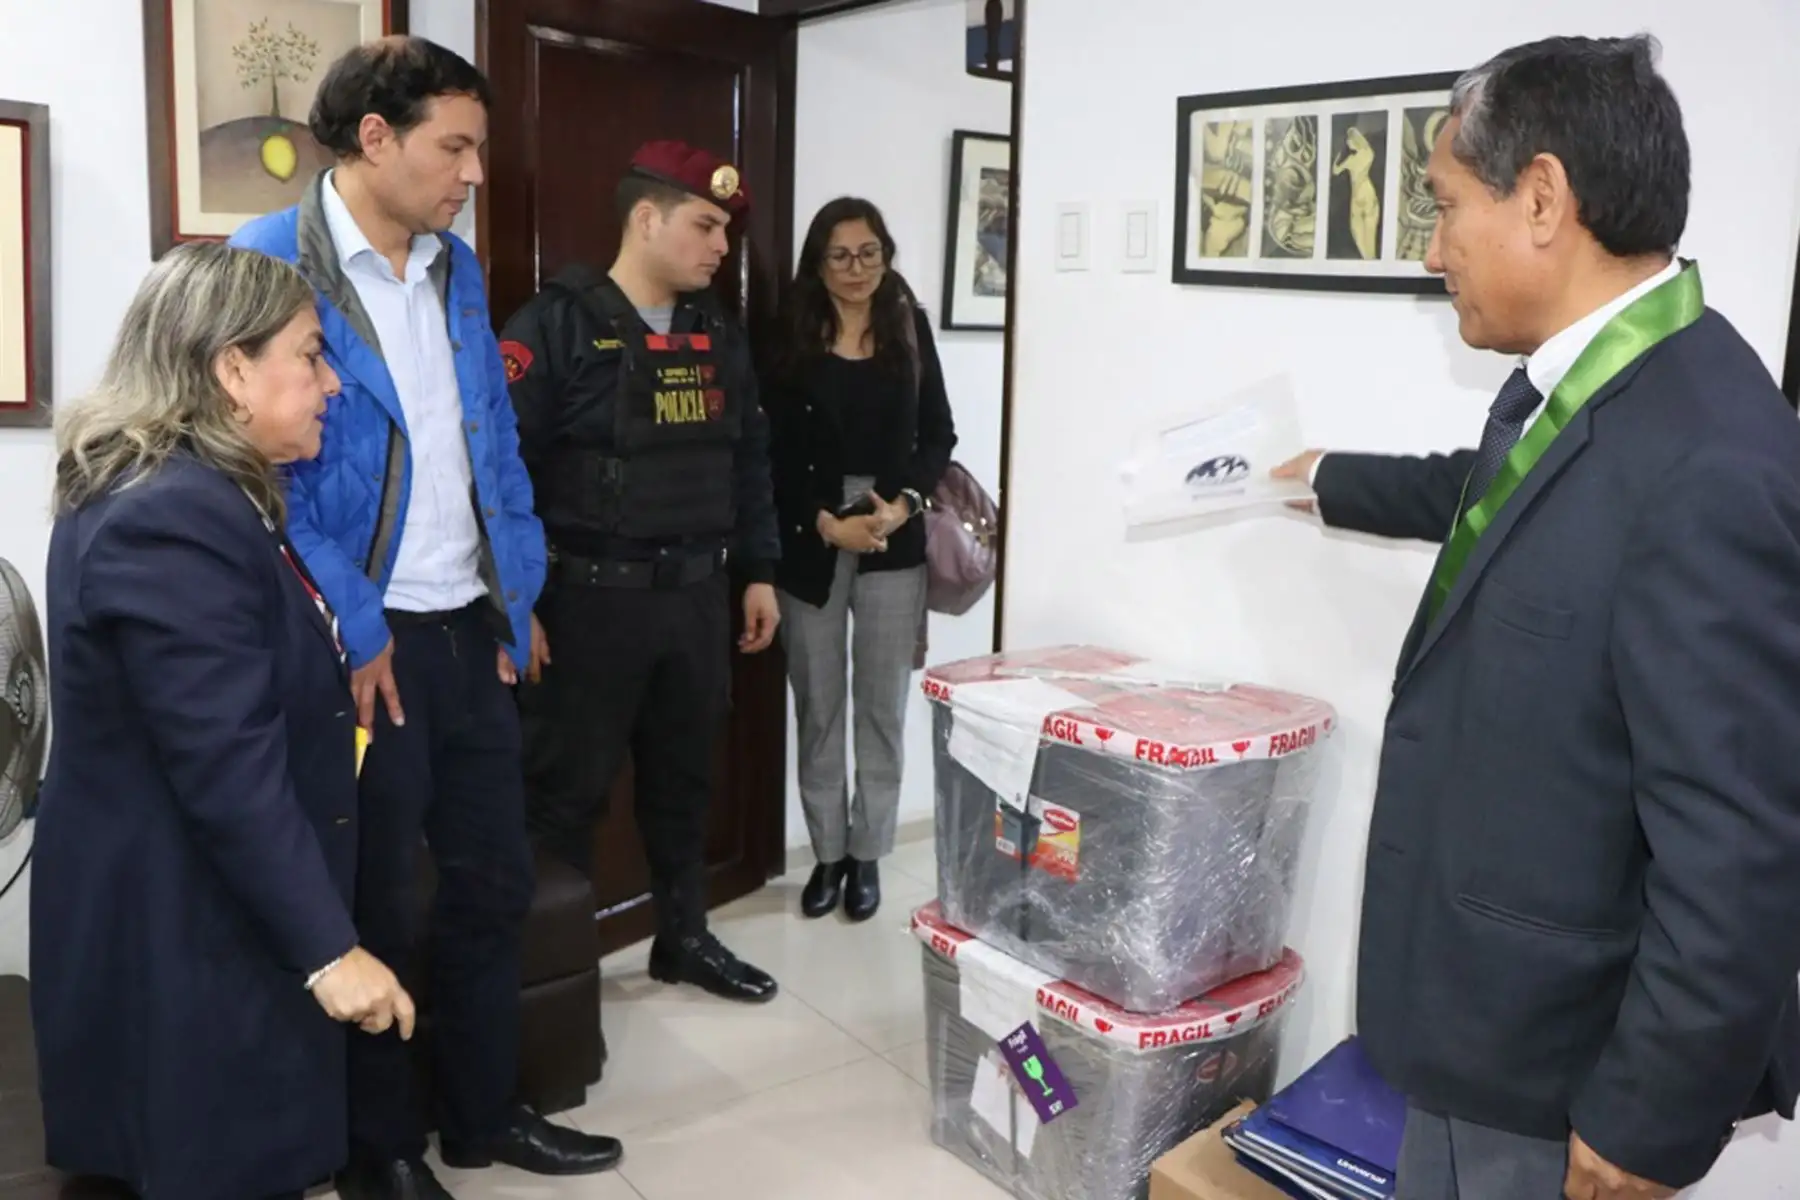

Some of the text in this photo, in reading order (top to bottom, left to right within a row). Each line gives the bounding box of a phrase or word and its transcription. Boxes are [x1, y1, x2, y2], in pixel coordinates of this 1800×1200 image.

[655, 389, 706, 424] POLICIA
[923, 679, 951, 701] FRA
[1040, 716, 1084, 745] AGIL
[1036, 987, 1080, 1022] RAGIL
[1138, 1023, 1213, 1049] FRAGIL
